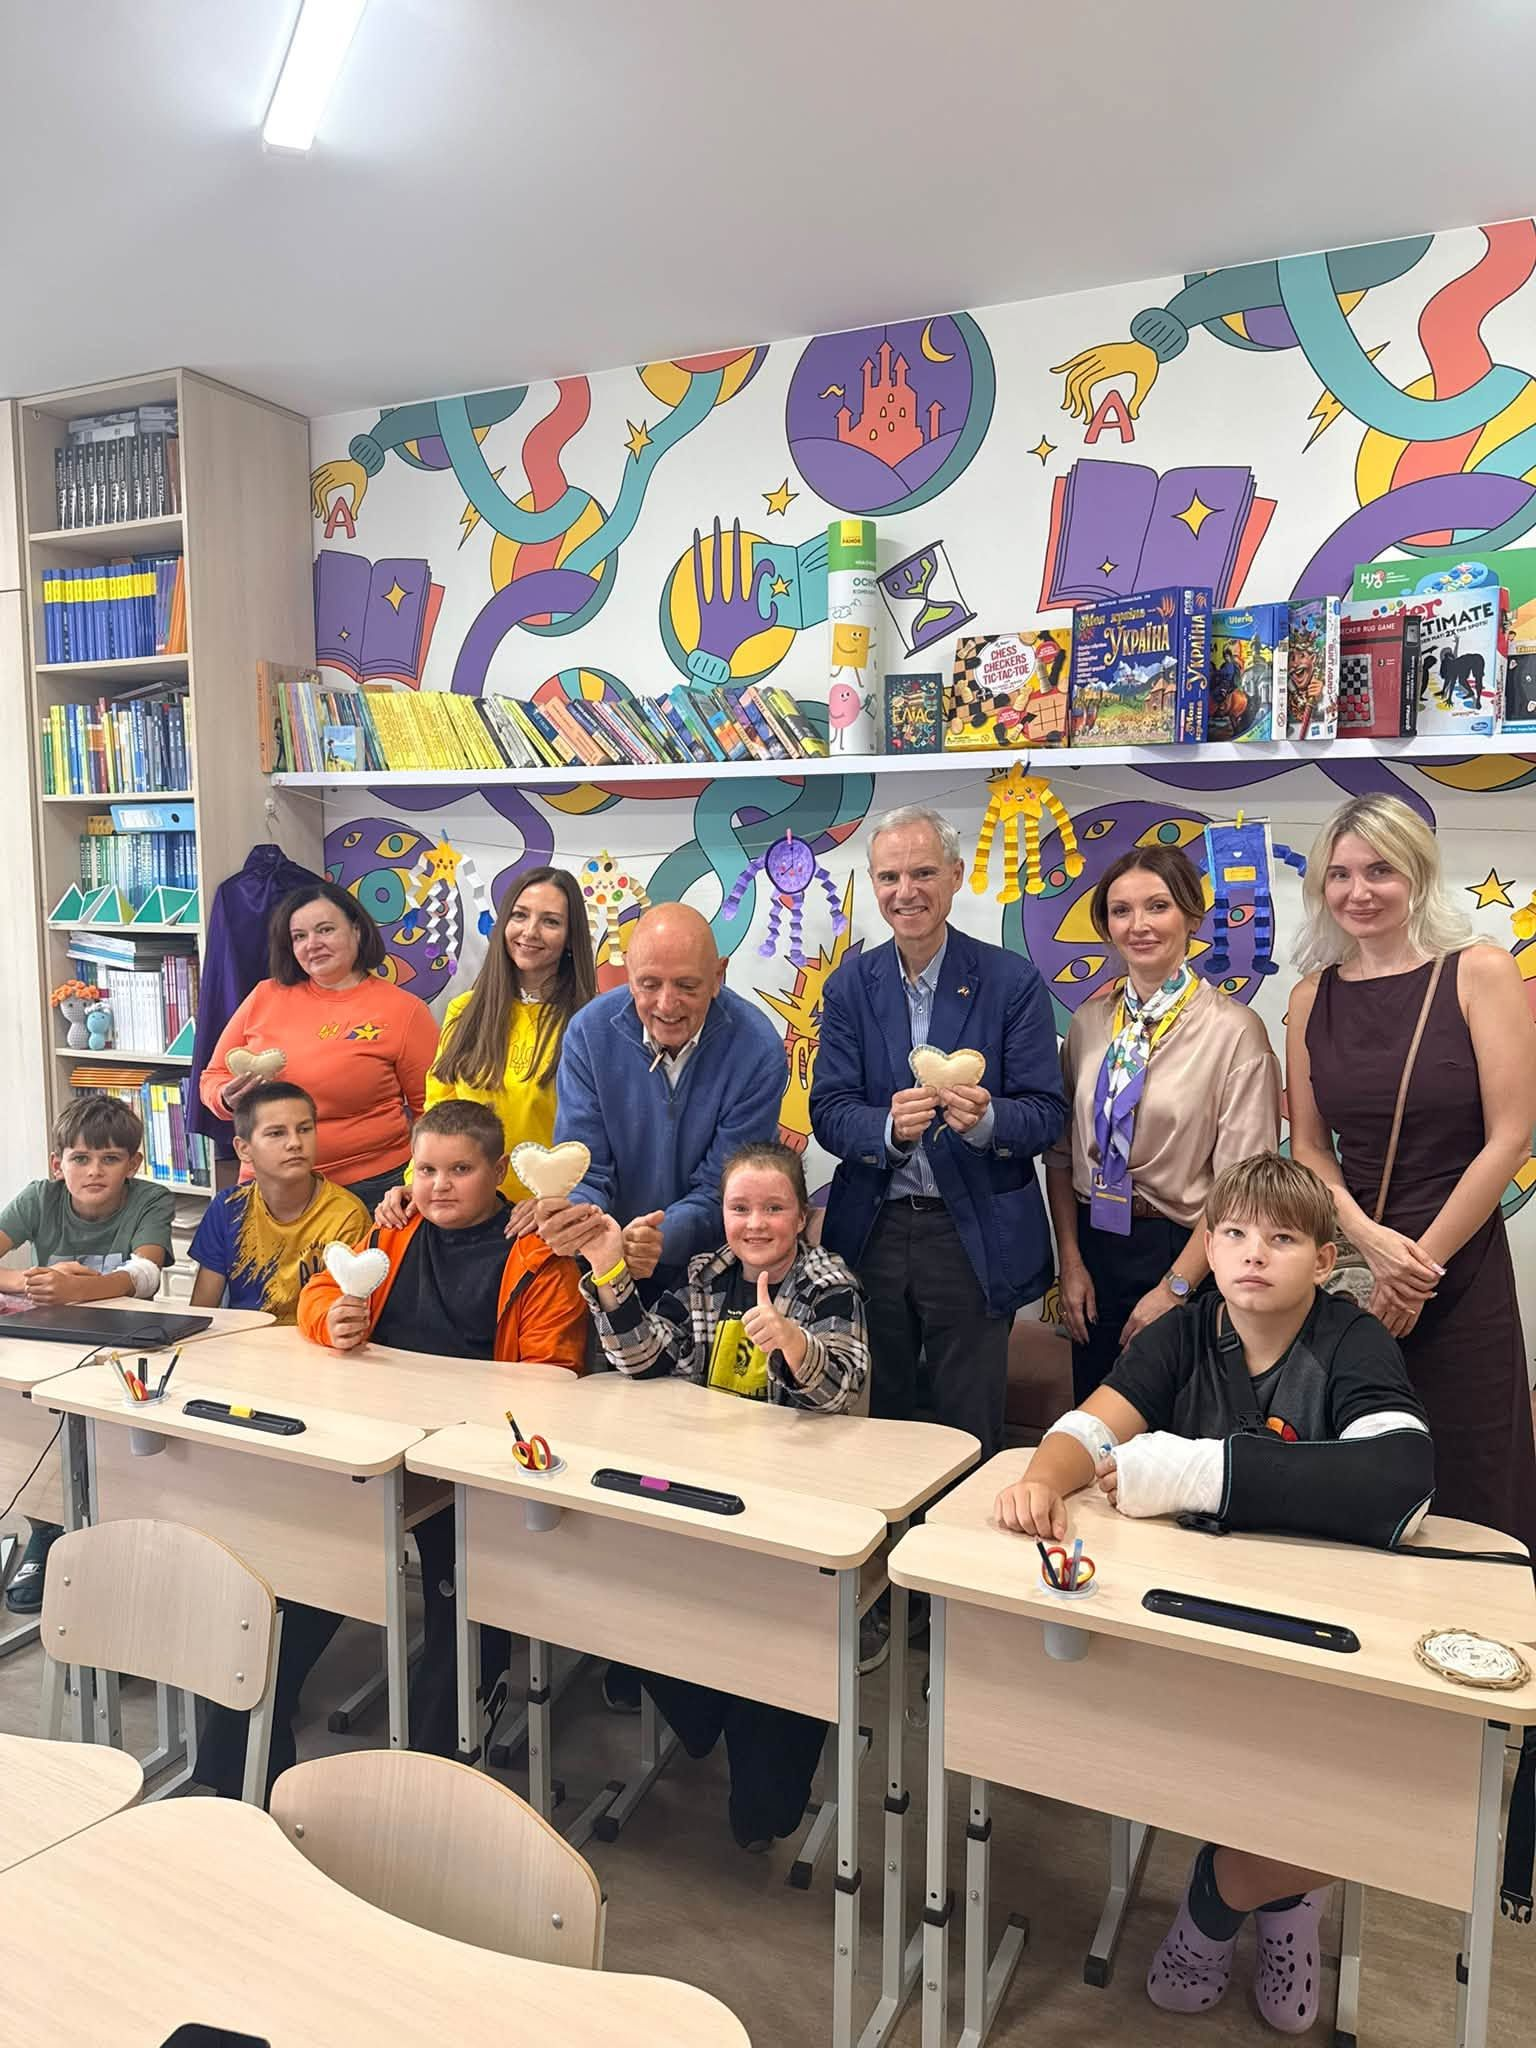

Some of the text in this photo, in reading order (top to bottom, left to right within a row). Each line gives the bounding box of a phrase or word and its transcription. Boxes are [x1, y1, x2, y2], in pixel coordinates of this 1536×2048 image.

[1084, 390, 1135, 444] A
[324, 496, 356, 539] A
[1377, 622, 1396, 631] GAME
[1445, 628, 1457, 637] 2X
[990, 645, 1017, 660] CHESS
[983, 653, 1027, 673] CHECKERS
[982, 663, 1030, 685] TIC-TAC-TOE
